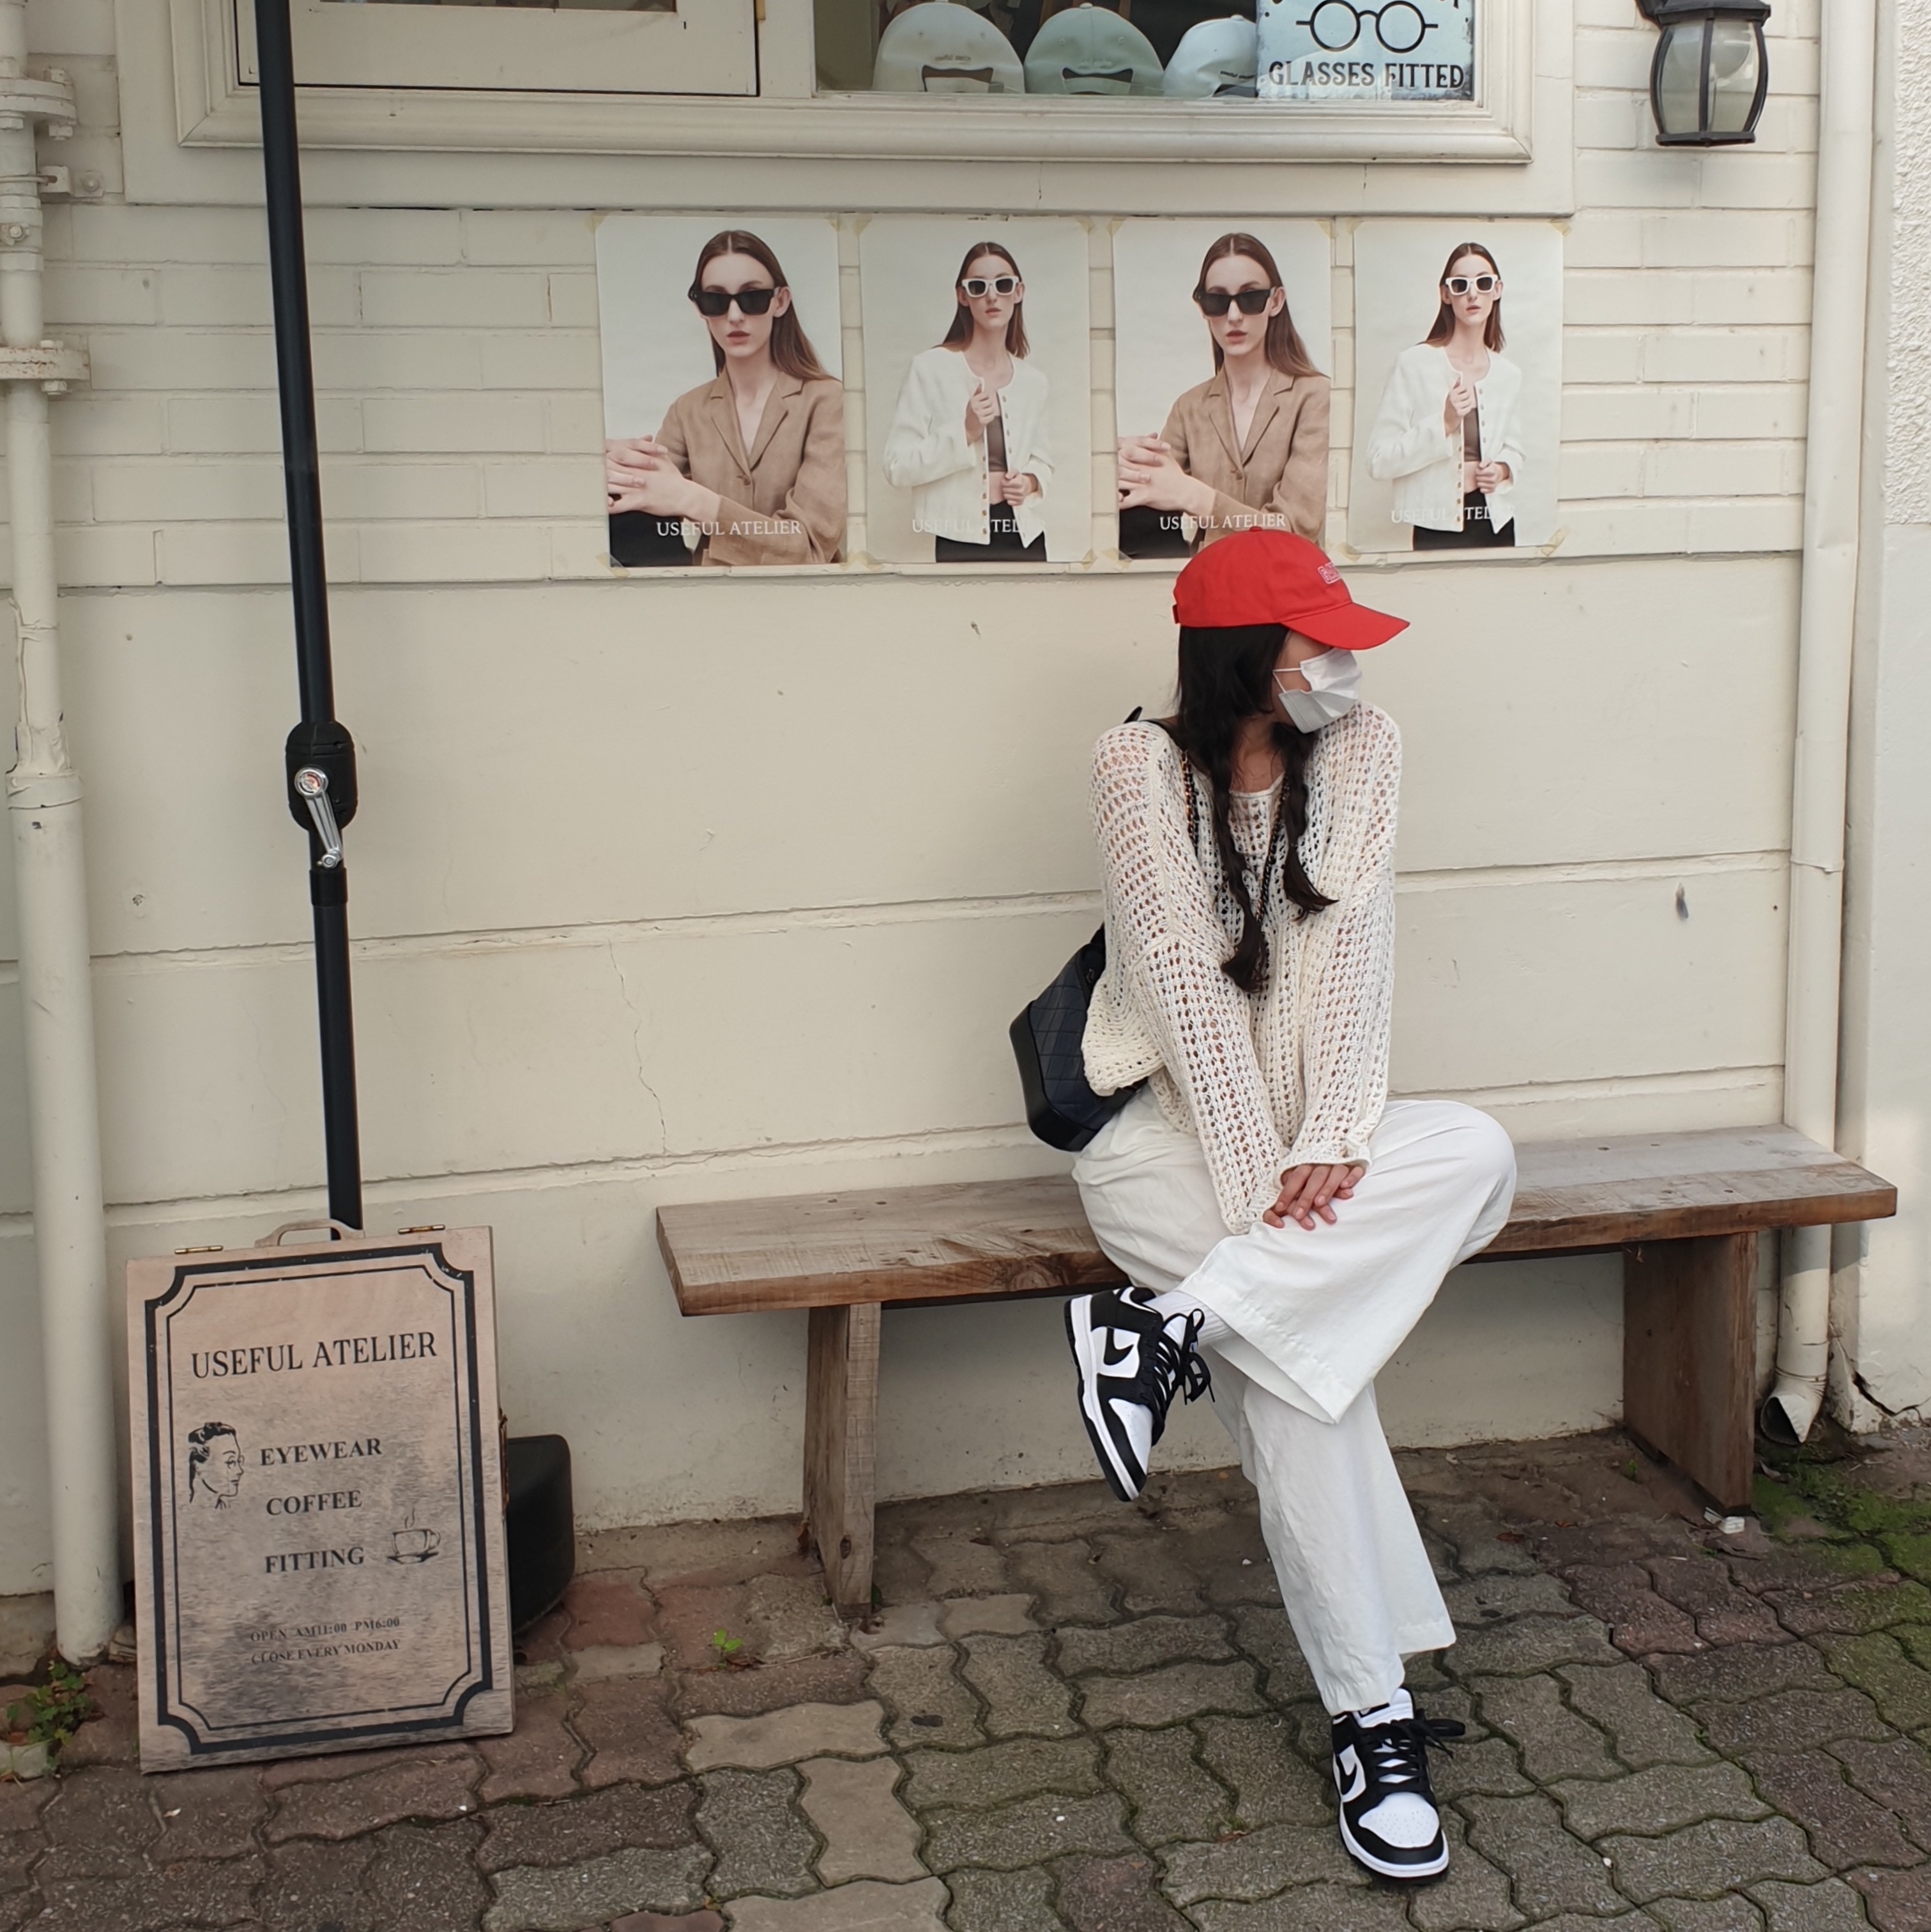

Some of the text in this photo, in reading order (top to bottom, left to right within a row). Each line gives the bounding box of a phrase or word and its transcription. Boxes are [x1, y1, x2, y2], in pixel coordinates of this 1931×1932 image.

[1269, 61, 1465, 89] GLASSES FITTED
[656, 520, 802, 536] USEFUL ATELIER
[1159, 513, 1286, 530] USEFUL ATELIER
[191, 1331, 438, 1379] USEFUL ATELIER
[259, 1437, 383, 1466] EYEWEAR
[266, 1489, 363, 1516] COFFEE
[264, 1546, 365, 1574] FITTING
[250, 1629, 287, 1643] OPEN
[354, 1616, 401, 1631] PM6:00
[251, 1638, 401, 1665] CLOSE EVERY MONDAY
